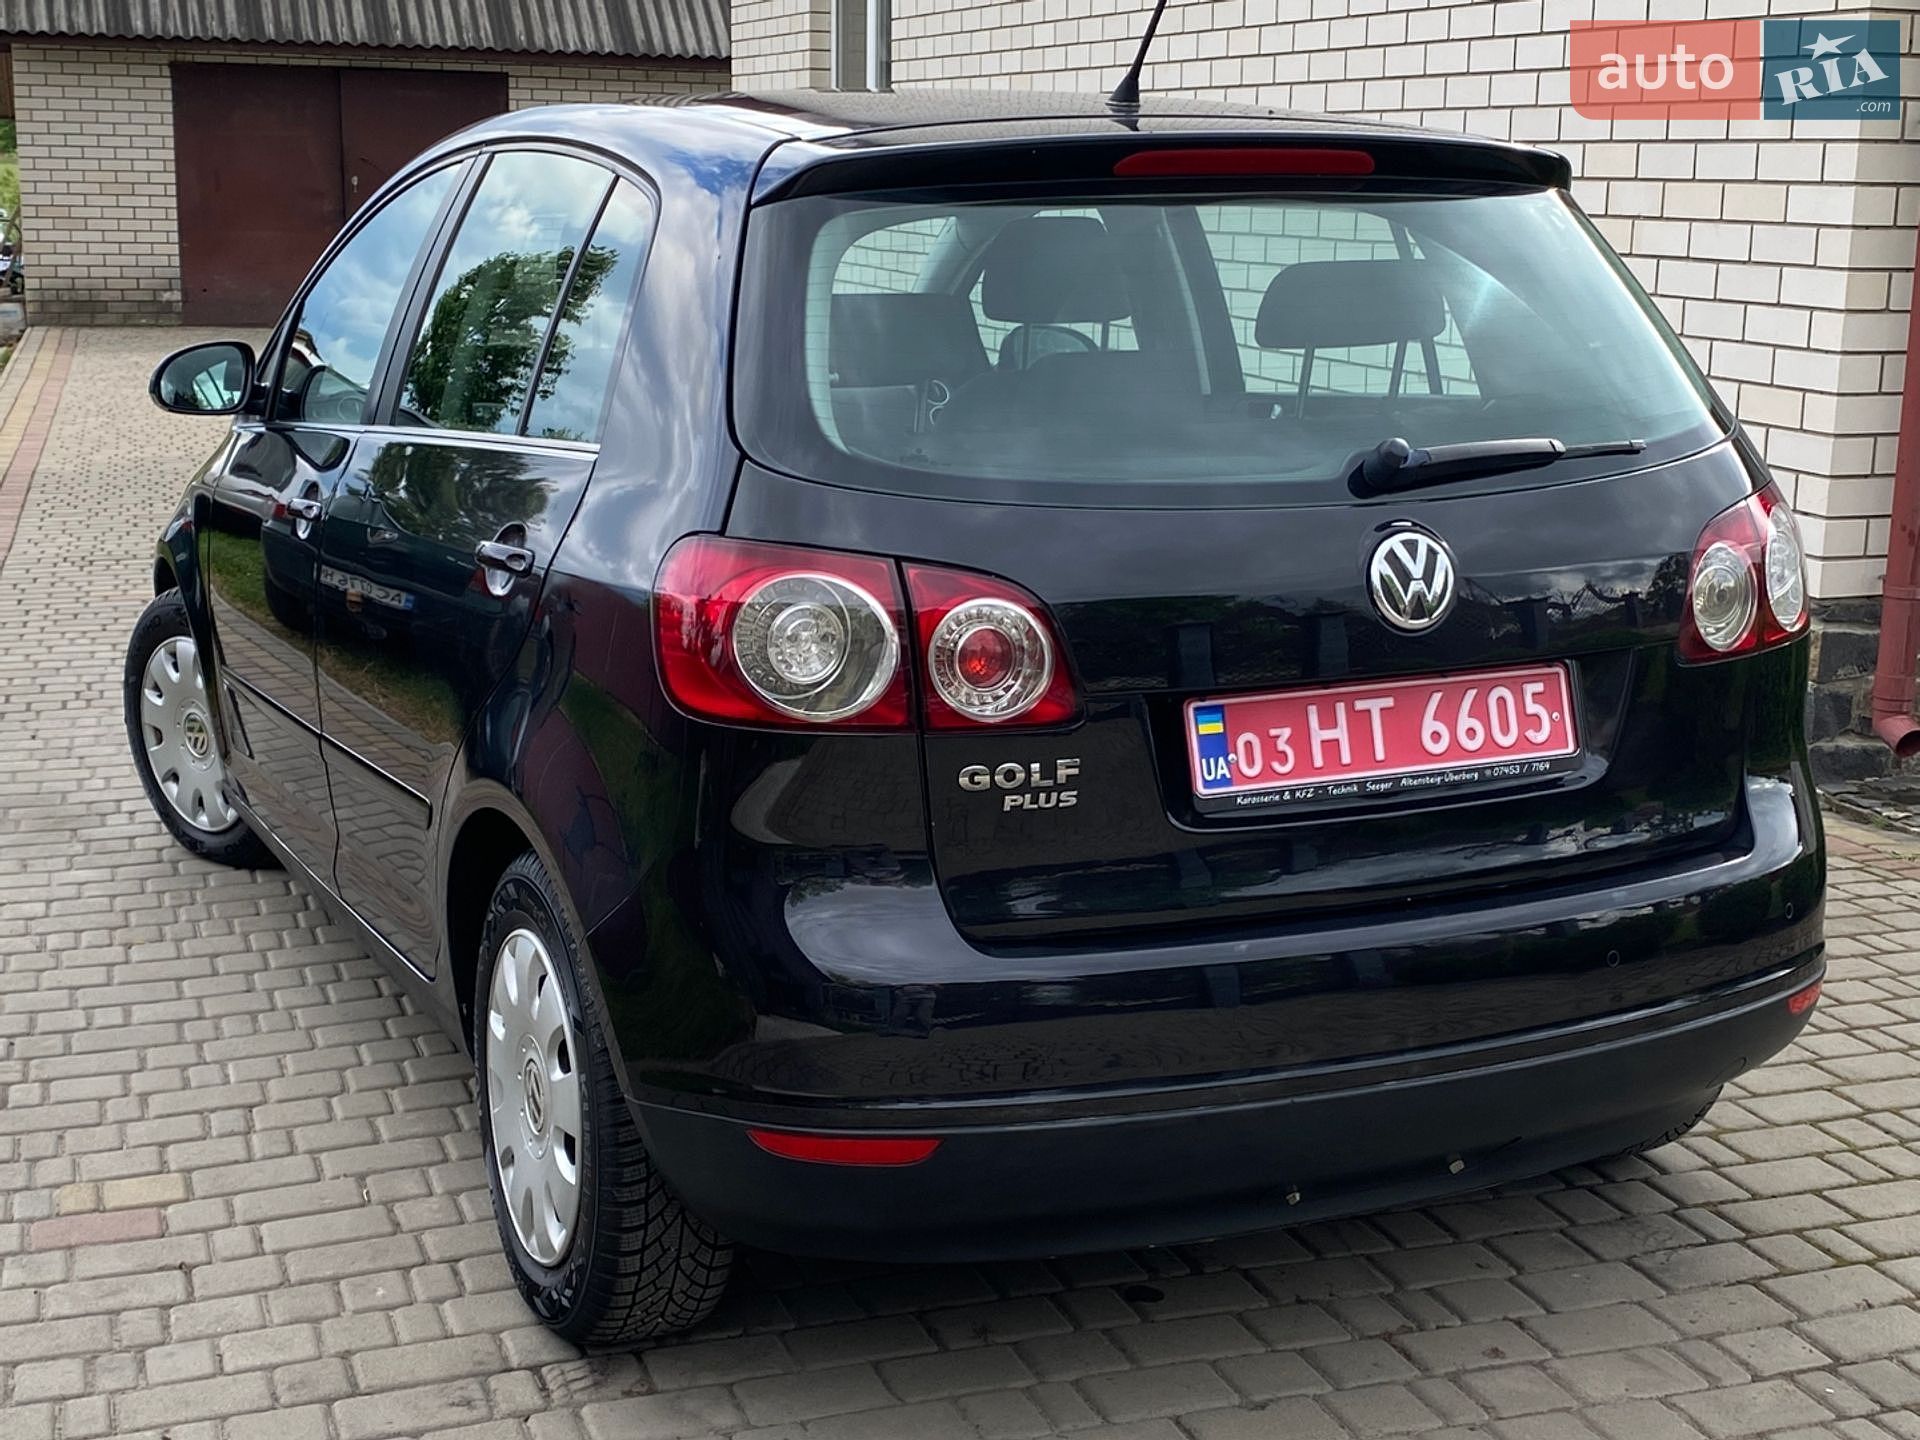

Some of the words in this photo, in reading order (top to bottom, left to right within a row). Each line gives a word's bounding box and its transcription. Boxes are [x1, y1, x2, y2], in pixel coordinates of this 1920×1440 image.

[1236, 727, 1295, 777] 03
[1307, 697, 1395, 769] HT
[1420, 681, 1551, 755] 6605
[958, 758, 1081, 791] GOLF
[1201, 755, 1231, 781] UA
[1003, 790, 1078, 811] PLUS
[1283, 791, 1291, 801] &
[1295, 788, 1315, 800] KFZ
[1327, 784, 1359, 797] Technik
